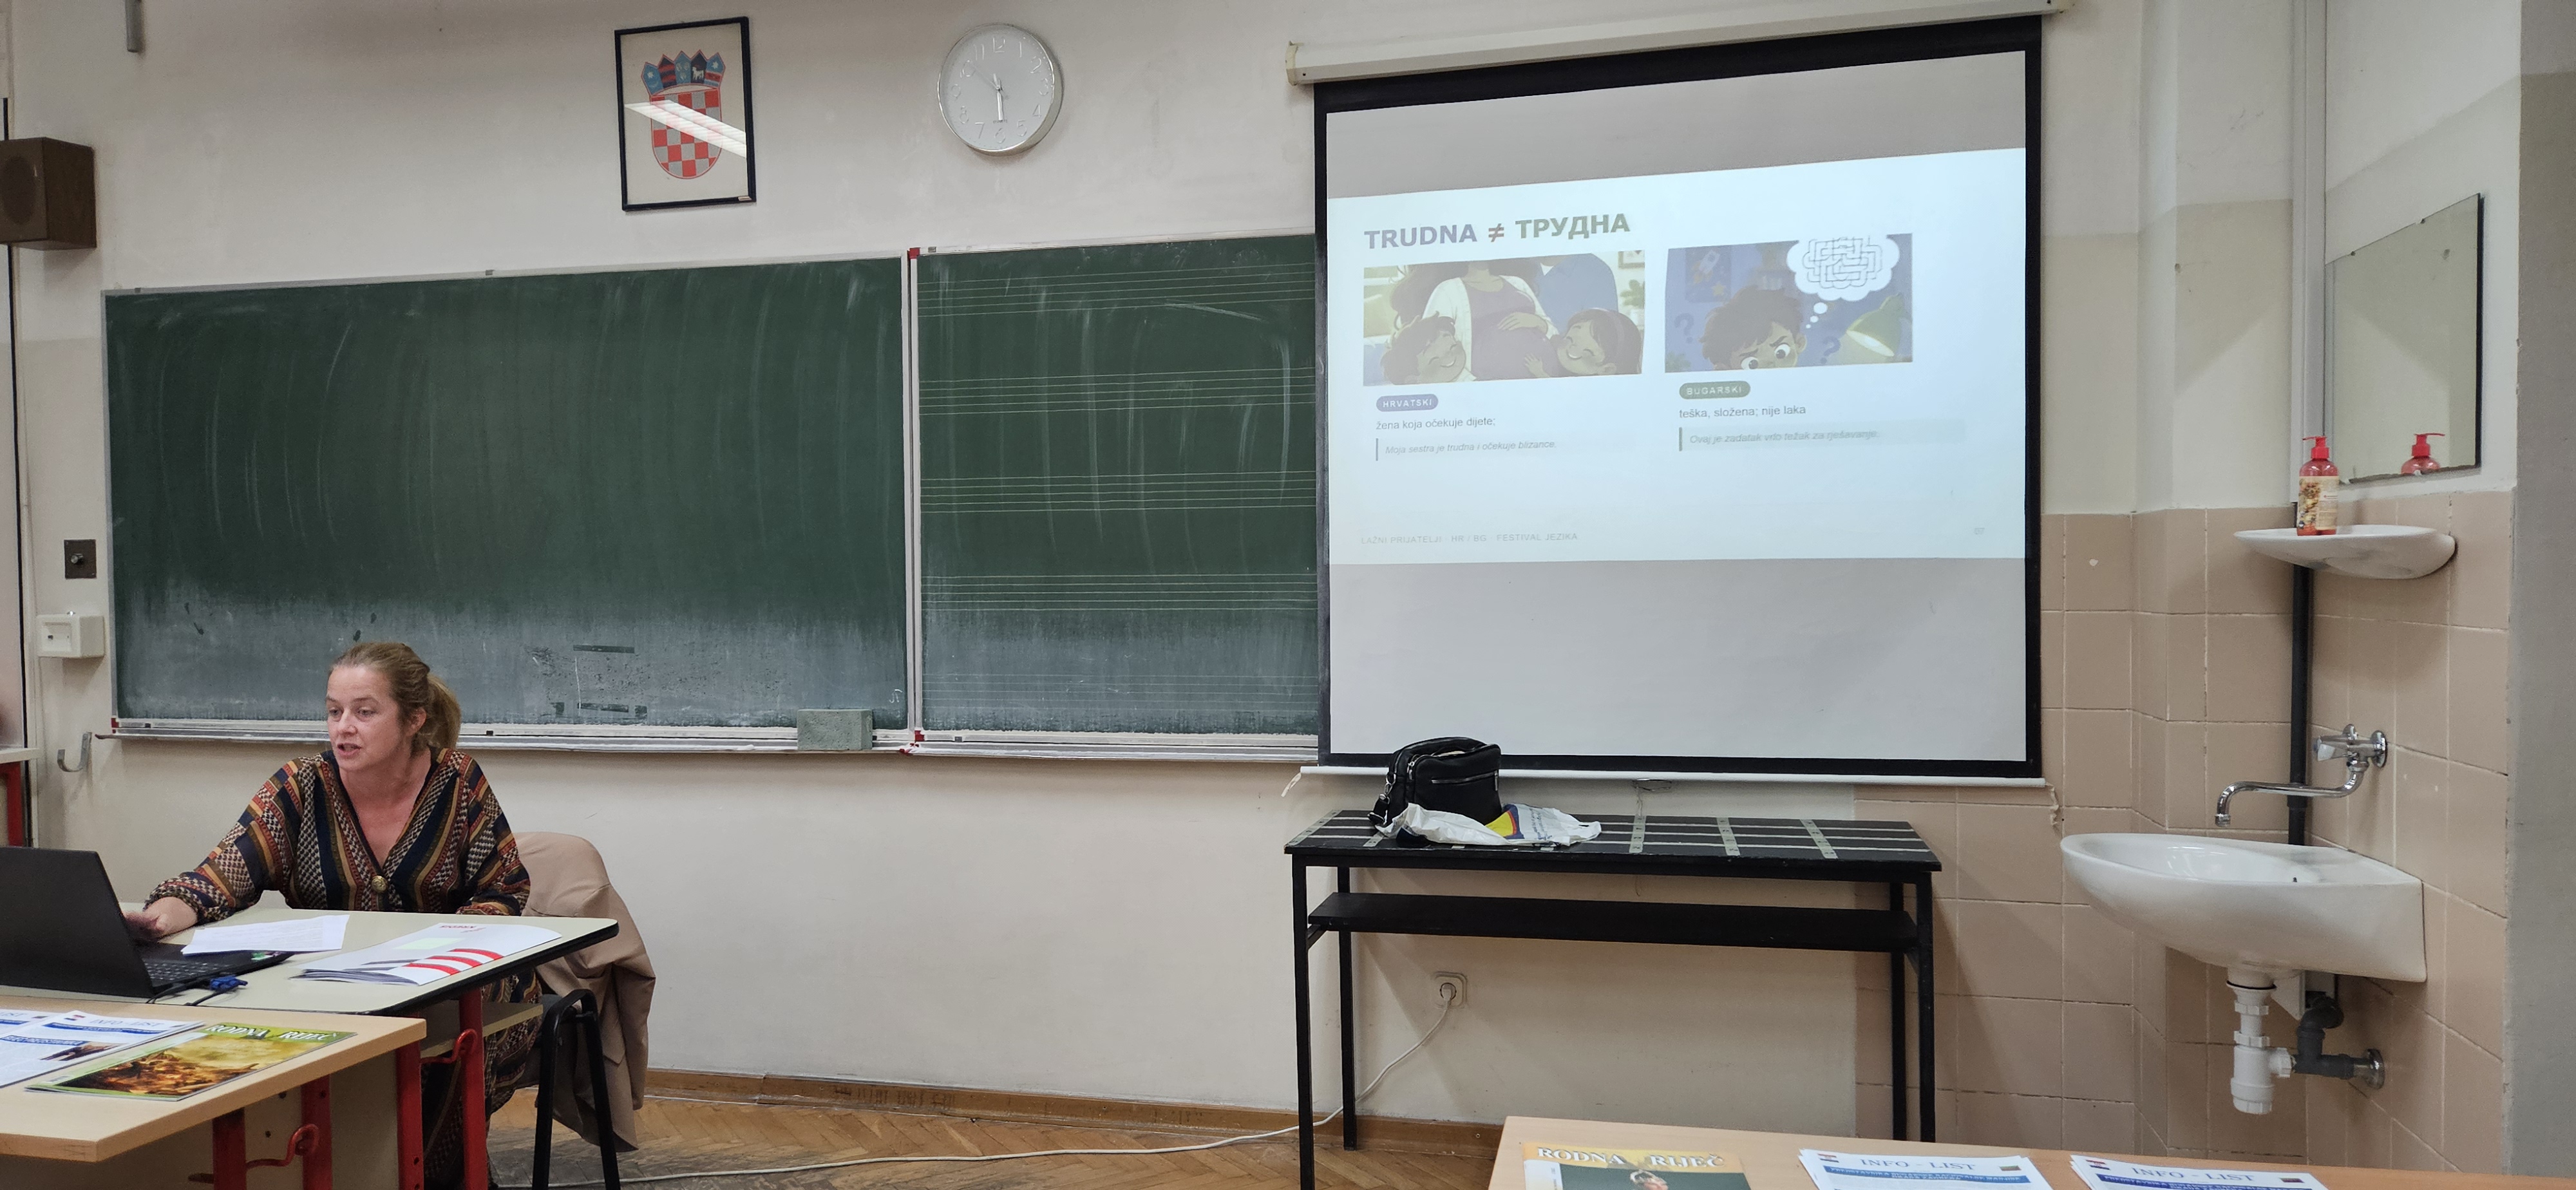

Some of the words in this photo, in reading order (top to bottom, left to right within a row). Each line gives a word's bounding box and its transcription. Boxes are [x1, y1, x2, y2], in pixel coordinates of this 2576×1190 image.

[1364, 223, 1477, 249] TRUDNA
[1515, 212, 1631, 240] ТРУДНА
[1686, 385, 1743, 396] BUGARSKI
[1382, 398, 1433, 408] HRVATSKI
[1679, 408, 1711, 419] teška,
[1714, 406, 1759, 419] složena;
[1761, 406, 1781, 418] nije
[1783, 404, 1806, 415] laka
[1376, 420, 1399, 430] žena
[1402, 419, 1423, 431] koja
[1425, 418, 1463, 430] očekuje
[1466, 417, 1496, 428] dijete;
[1690, 433, 1712, 446] Ovaj
[1712, 433, 1723, 445] je
[1725, 432, 1761, 443] zadatak
[1783, 431, 1810, 442] težak
[1812, 432, 1824, 440] za
[1385, 446, 1406, 455] Moja
[1408, 444, 1435, 453] sestra
[1436, 444, 1444, 455] je
[1447, 442, 1475, 452] trudna
[1482, 441, 1516, 452] očekuje
[1518, 440, 1557, 450] blizance.
[1361, 535, 1387, 545] LAŽNI
[1390, 536, 1442, 544] PRIJATELJI
[1496, 533, 1542, 542] FESTIVAL
[1545, 533, 1578, 541] JEZIKA
[1537, 1147, 1626, 1165] RODNA
[1649, 1153, 1727, 1168] RIJEČ
[1859, 1158, 1909, 1168] INFO
[1929, 1161, 1976, 1171] LIST
[2132, 1167, 2184, 1178] INFO
[2206, 1173, 2255, 1182] LIST
